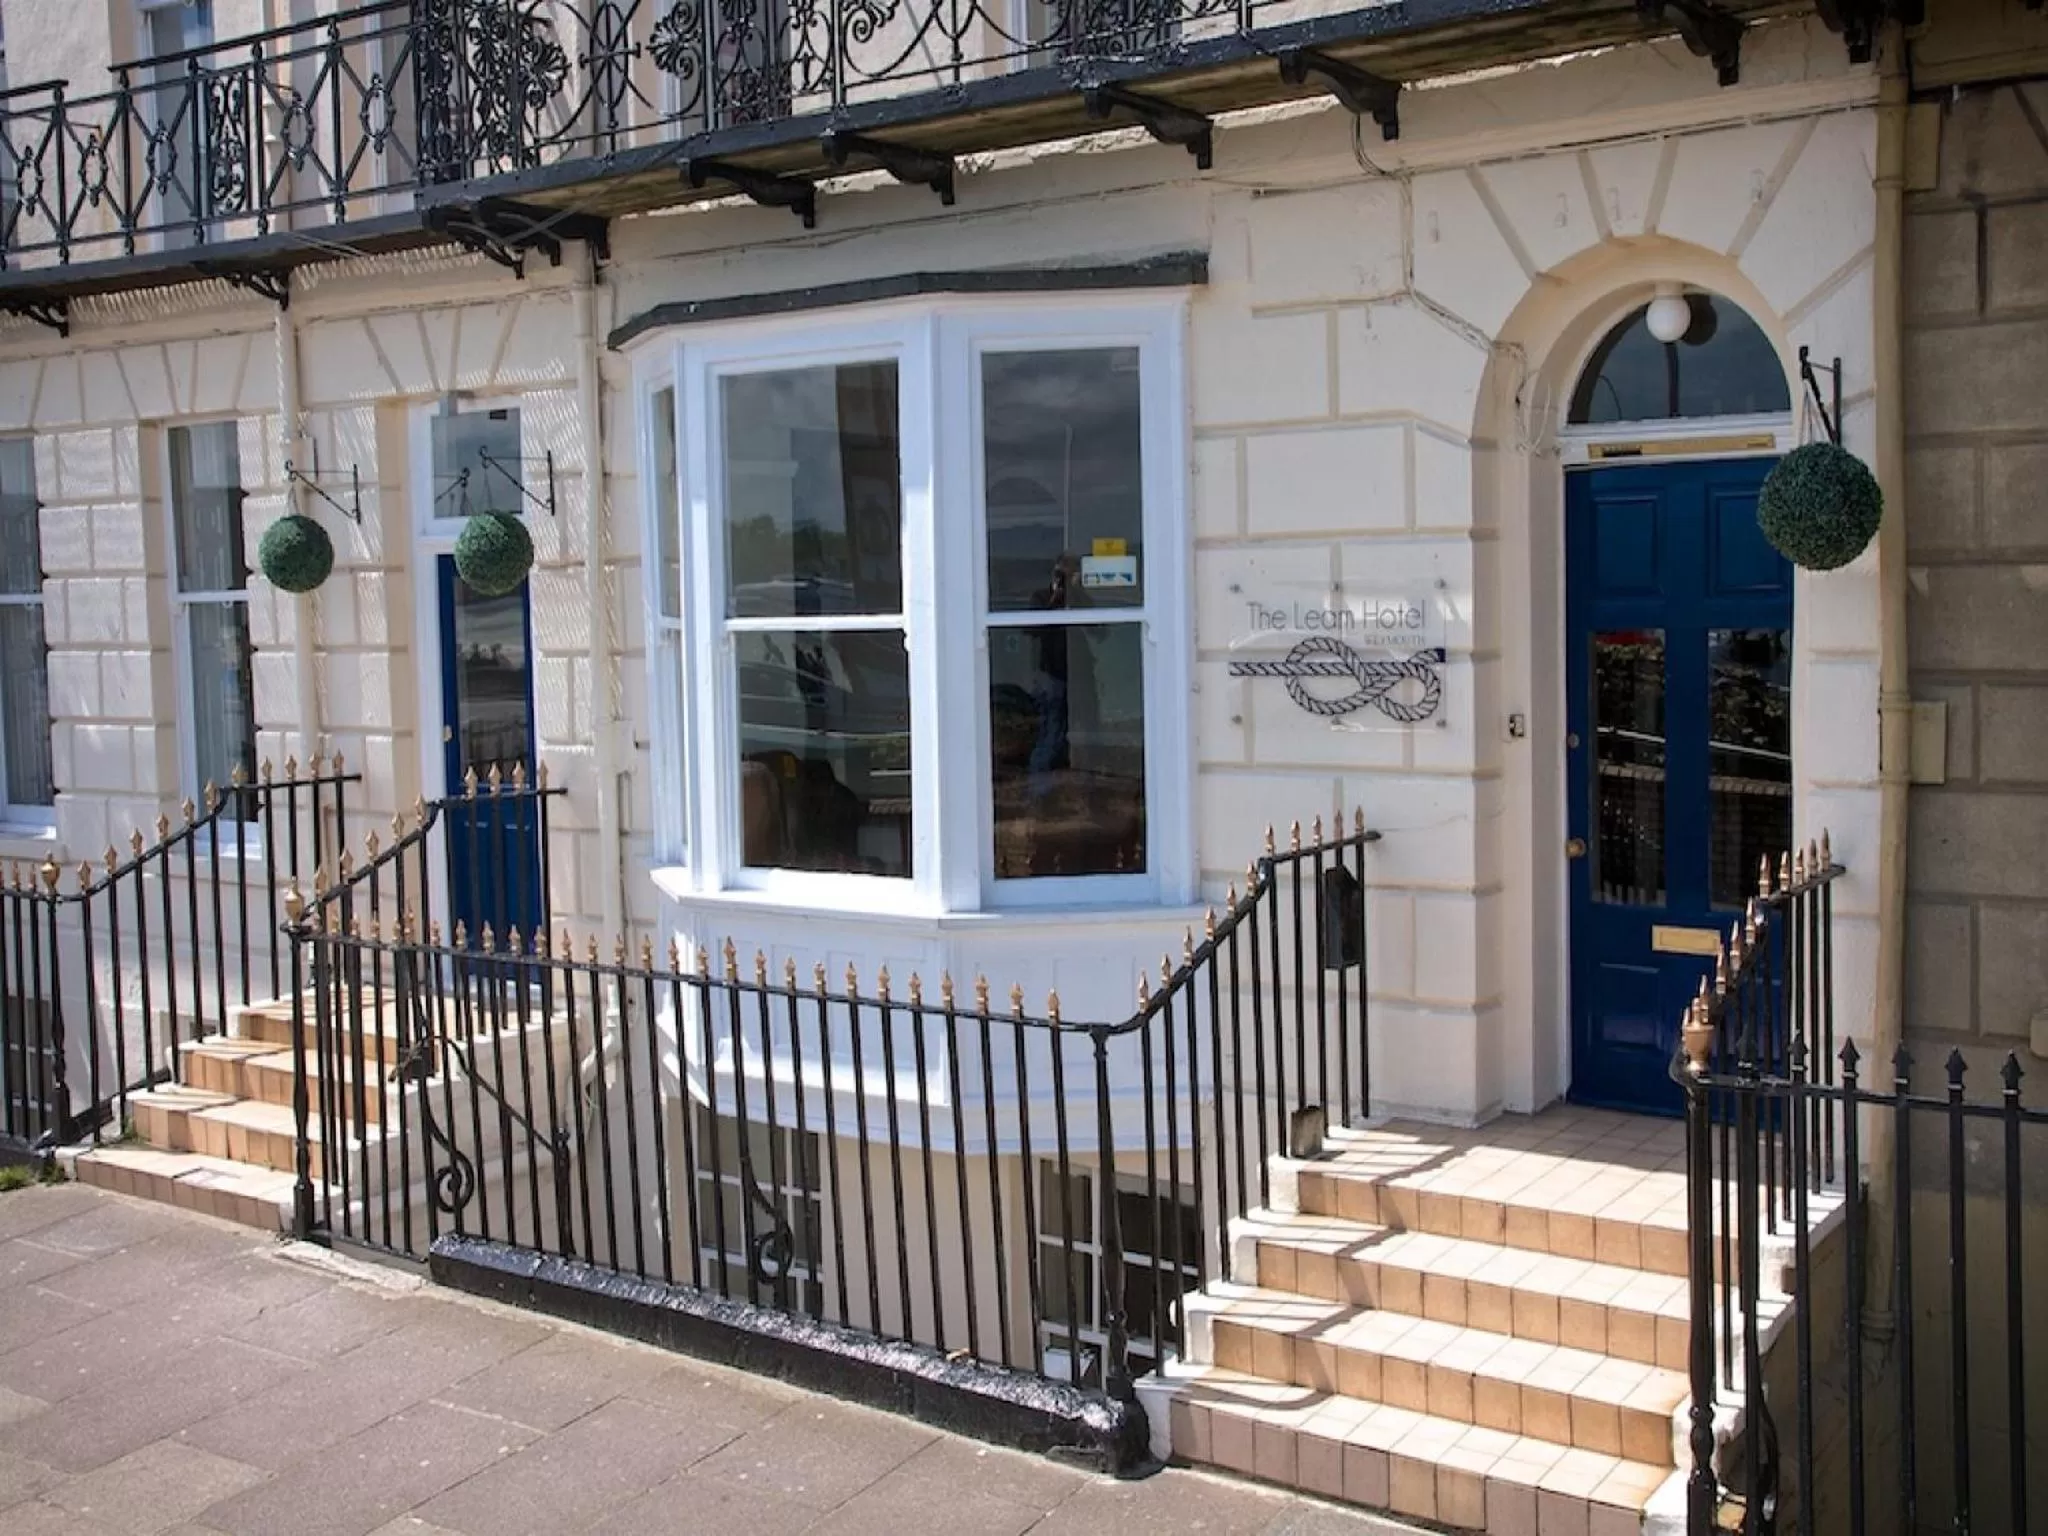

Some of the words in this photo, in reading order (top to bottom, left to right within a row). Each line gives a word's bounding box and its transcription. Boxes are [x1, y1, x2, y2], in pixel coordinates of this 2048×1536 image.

[1246, 601, 1287, 630] The
[1294, 601, 1355, 630] Leam
[1363, 600, 1426, 630] Hotel
